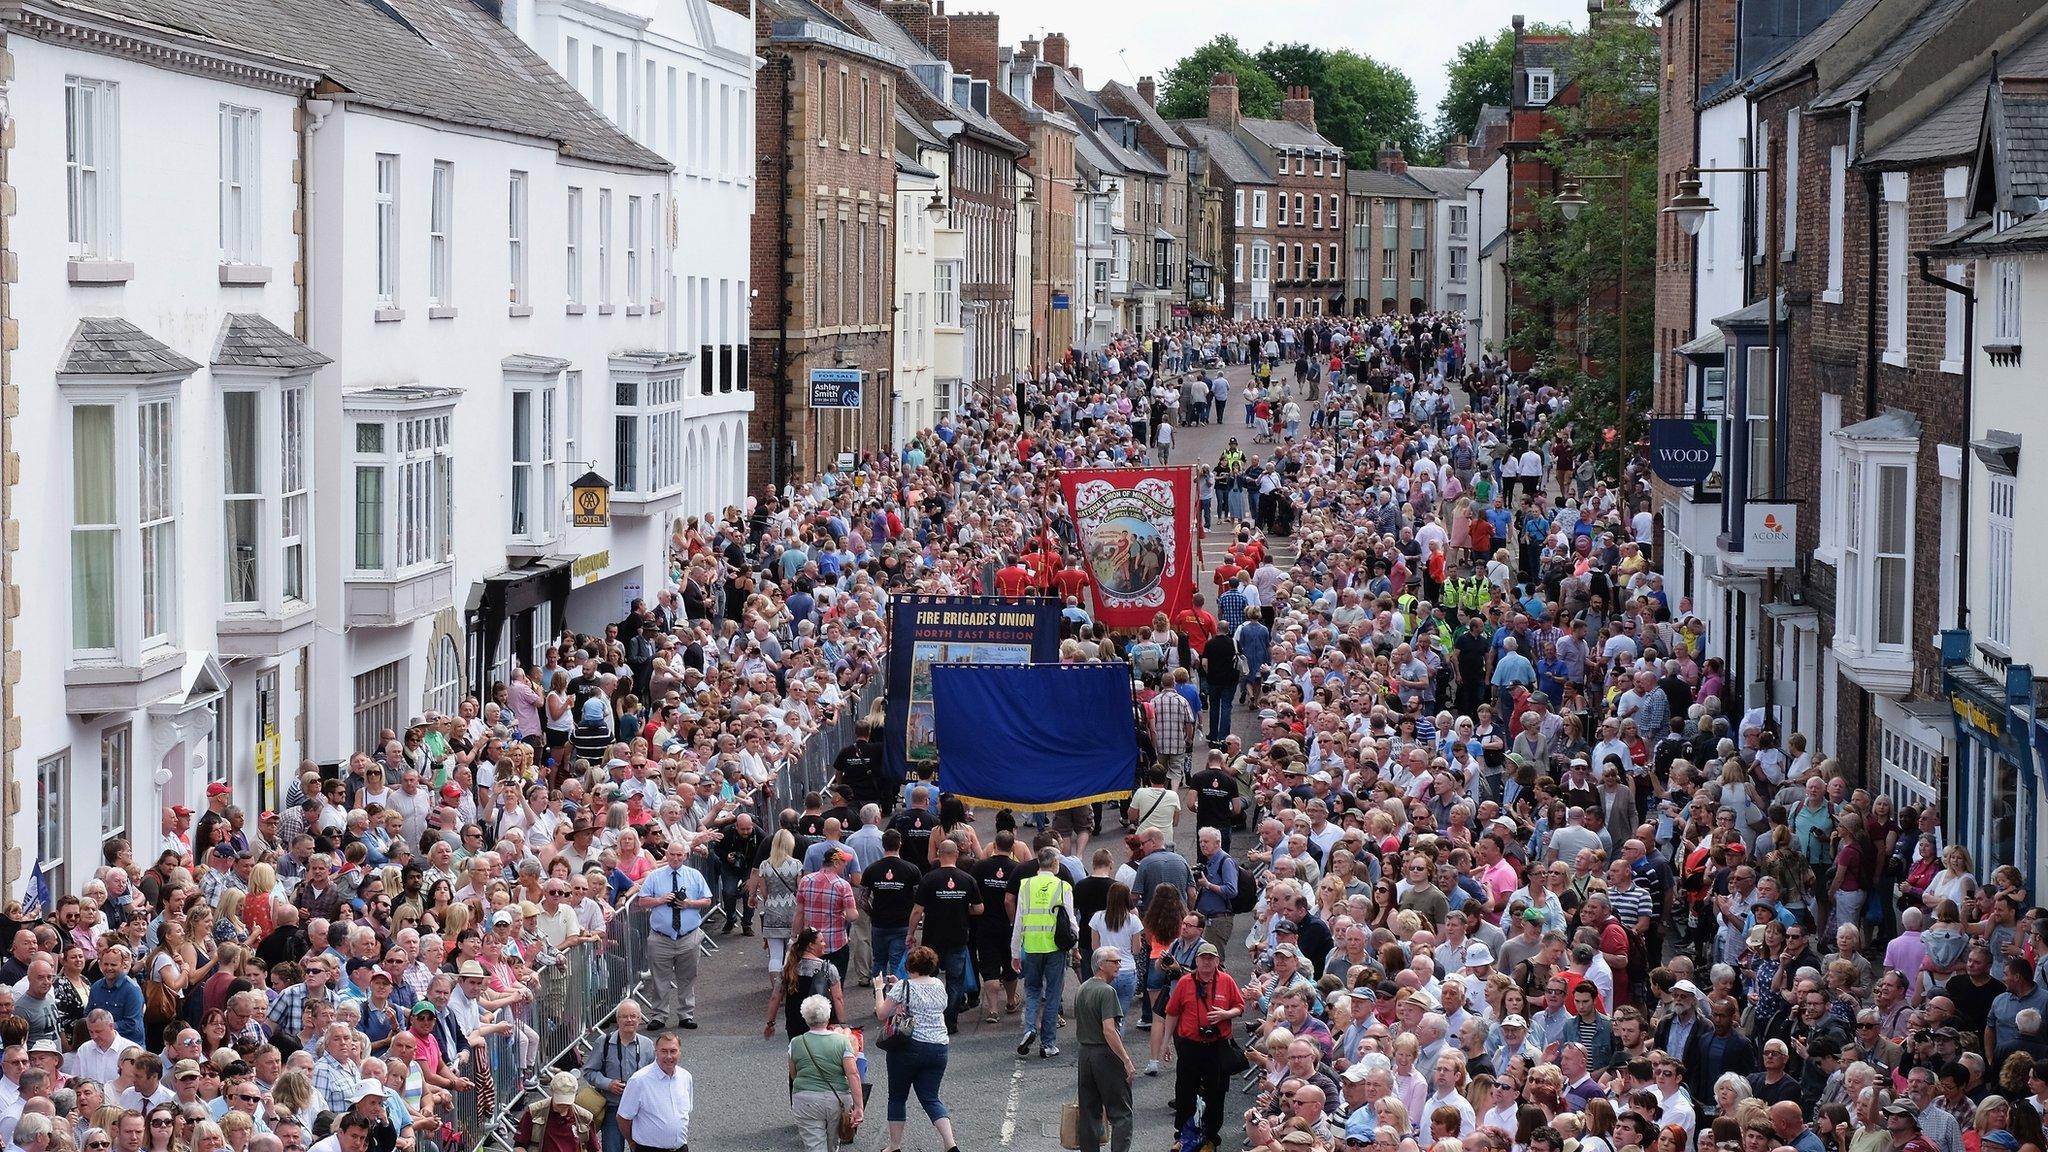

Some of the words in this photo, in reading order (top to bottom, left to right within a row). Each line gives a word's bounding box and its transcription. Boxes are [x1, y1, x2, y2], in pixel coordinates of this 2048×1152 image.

[814, 383, 840, 391] Ashley
[814, 390, 838, 398] Smith
[1659, 448, 1709, 462] WOOD
[1077, 501, 1105, 517] NATIONAL
[1104, 491, 1121, 502] UNION
[1132, 491, 1173, 515] MINEWORKERS
[576, 515, 603, 524] HOTEL
[916, 611, 940, 625] FIRE
[943, 612, 996, 626] BRIGADES
[999, 613, 1035, 627] UNION
[915, 630, 952, 638] NORTH
[957, 631, 984, 639] EAST
[988, 631, 1034, 640] REGION
